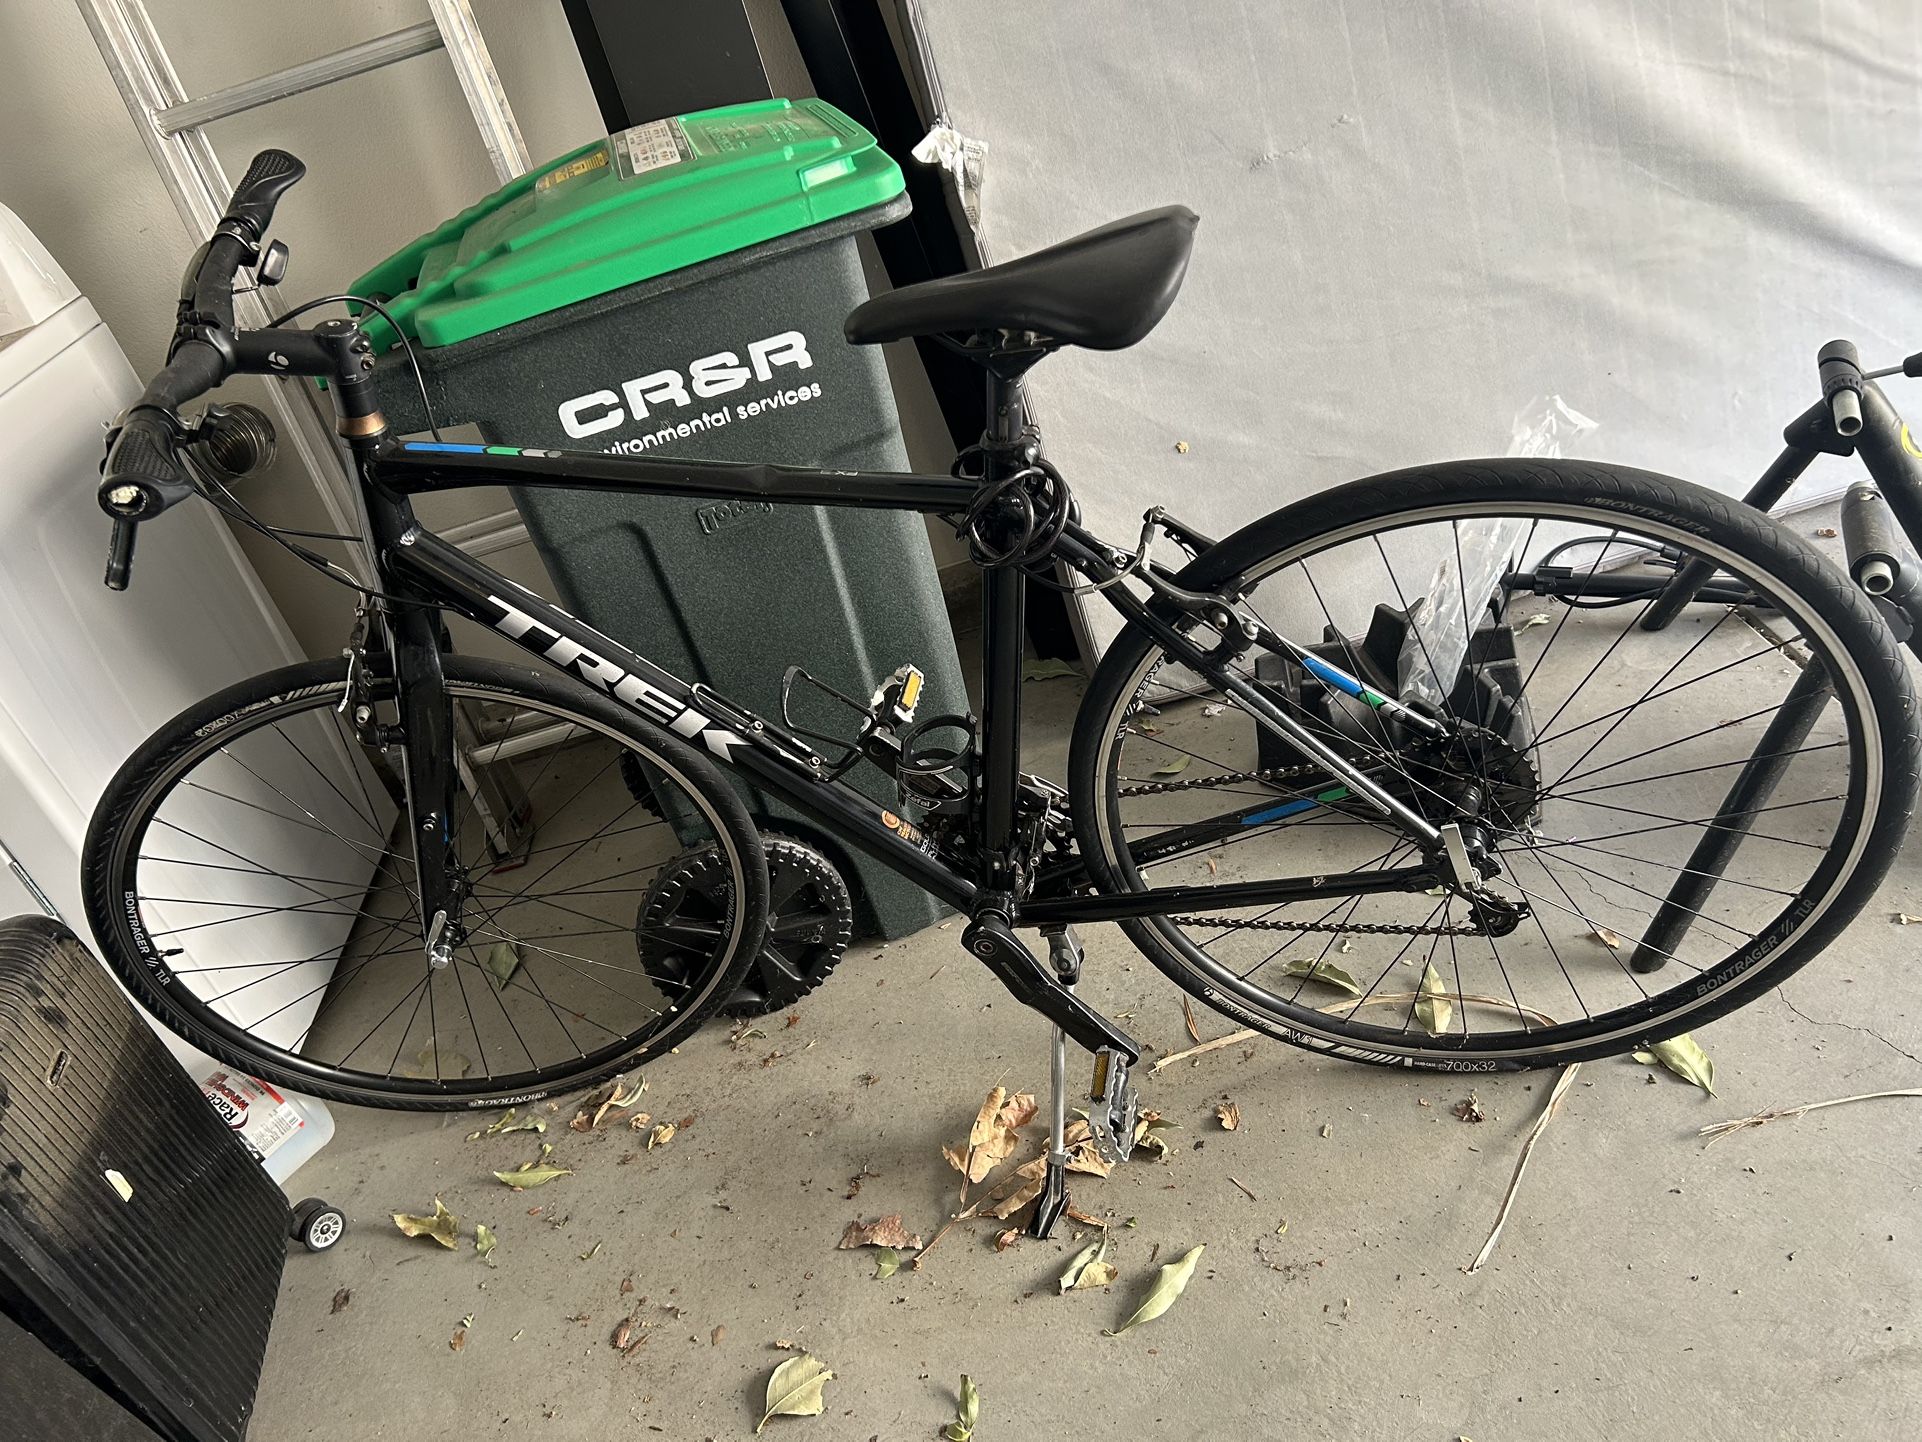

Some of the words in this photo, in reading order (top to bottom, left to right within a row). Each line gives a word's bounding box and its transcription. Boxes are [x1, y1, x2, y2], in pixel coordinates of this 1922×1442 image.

[558, 331, 813, 439] CR&R
[738, 382, 822, 420] services
[487, 594, 752, 764] TREK
[1134, 655, 1166, 699] RAGER
[723, 880, 735, 940] BONTRAGER
[124, 891, 150, 954] BONTRAGER
[155, 969, 171, 986] TLR
[1696, 935, 1780, 997] BONTRAGER
[1793, 898, 1816, 919] TLR
[1217, 998, 1272, 1030] BONTRAGER
[1446, 1060, 1497, 1072] 700x32
[207, 1092, 239, 1122] Race
